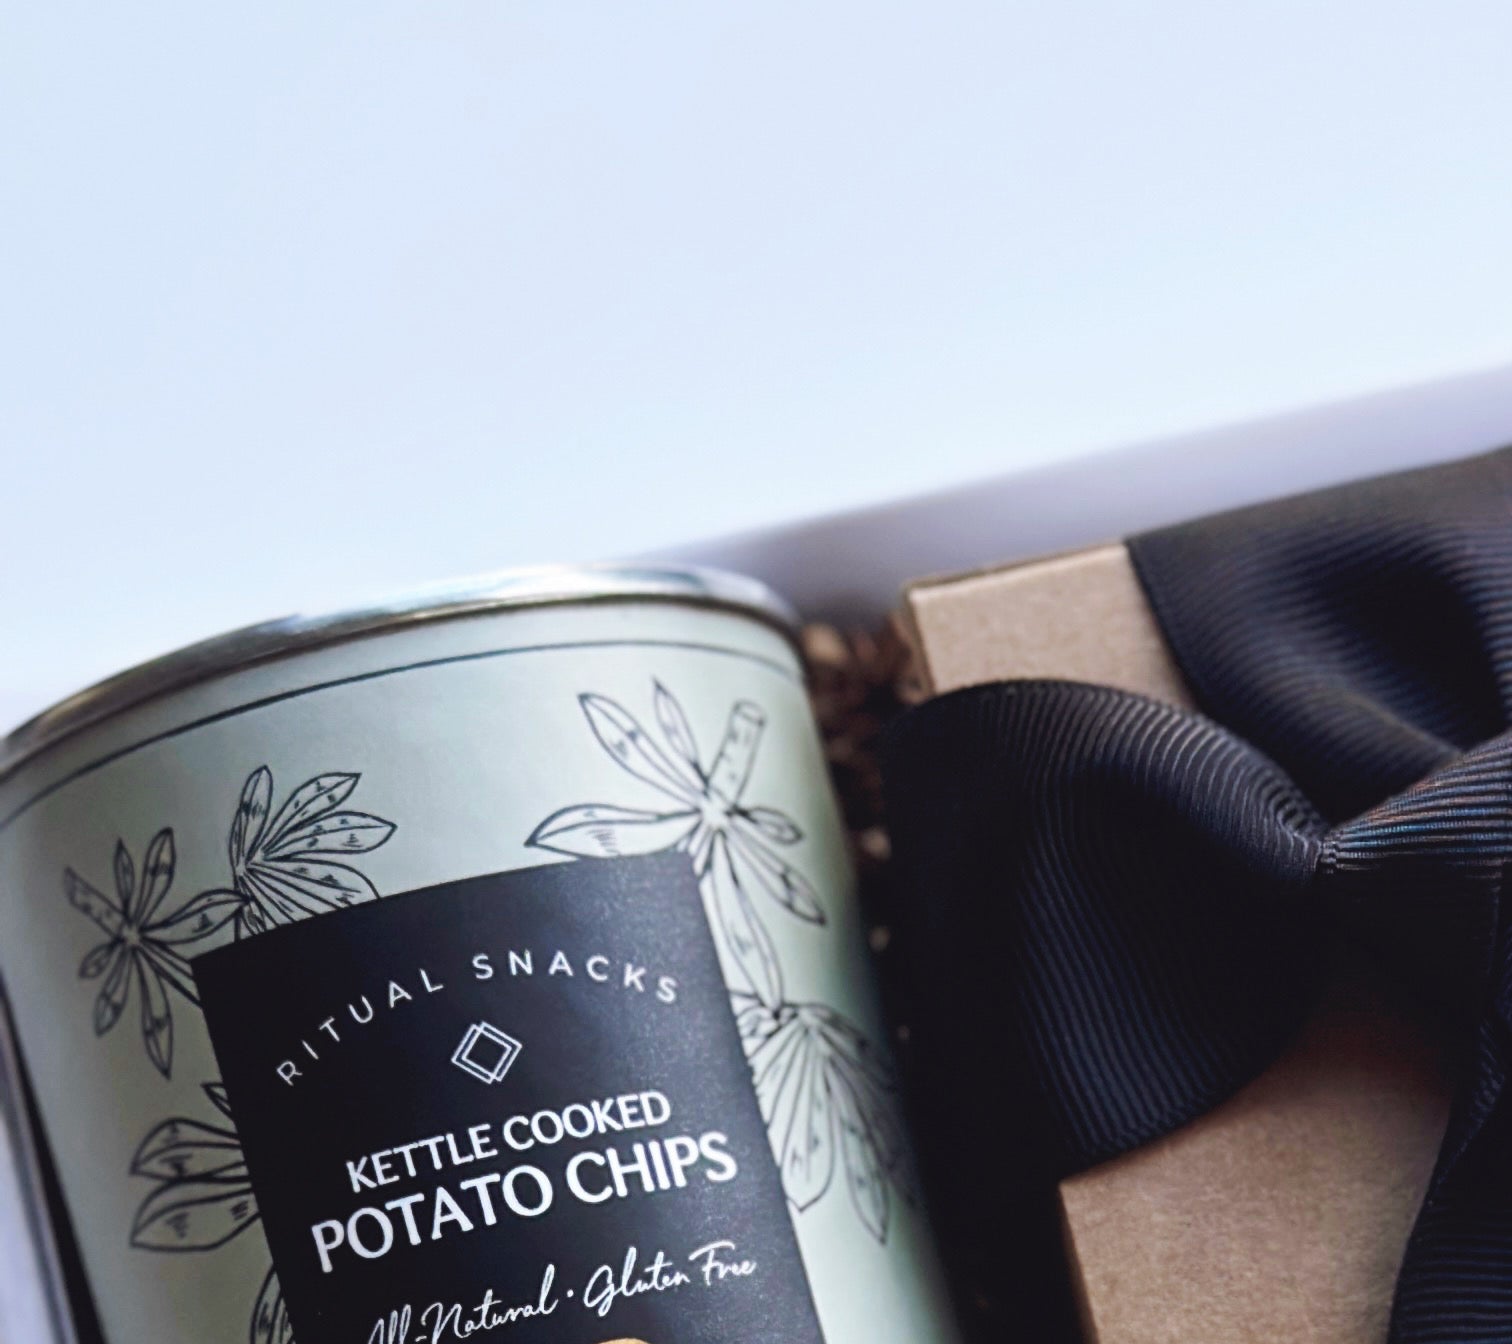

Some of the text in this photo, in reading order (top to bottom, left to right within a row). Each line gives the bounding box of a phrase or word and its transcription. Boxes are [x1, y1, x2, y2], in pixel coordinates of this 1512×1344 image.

[276, 949, 678, 1086] RITUAL SNACKS
[346, 1090, 671, 1193] KETTLE COOKED
[311, 1131, 738, 1273] POTATO CHIPS
[583, 1247, 692, 1317] Gluten
[690, 1240, 760, 1289] Free
